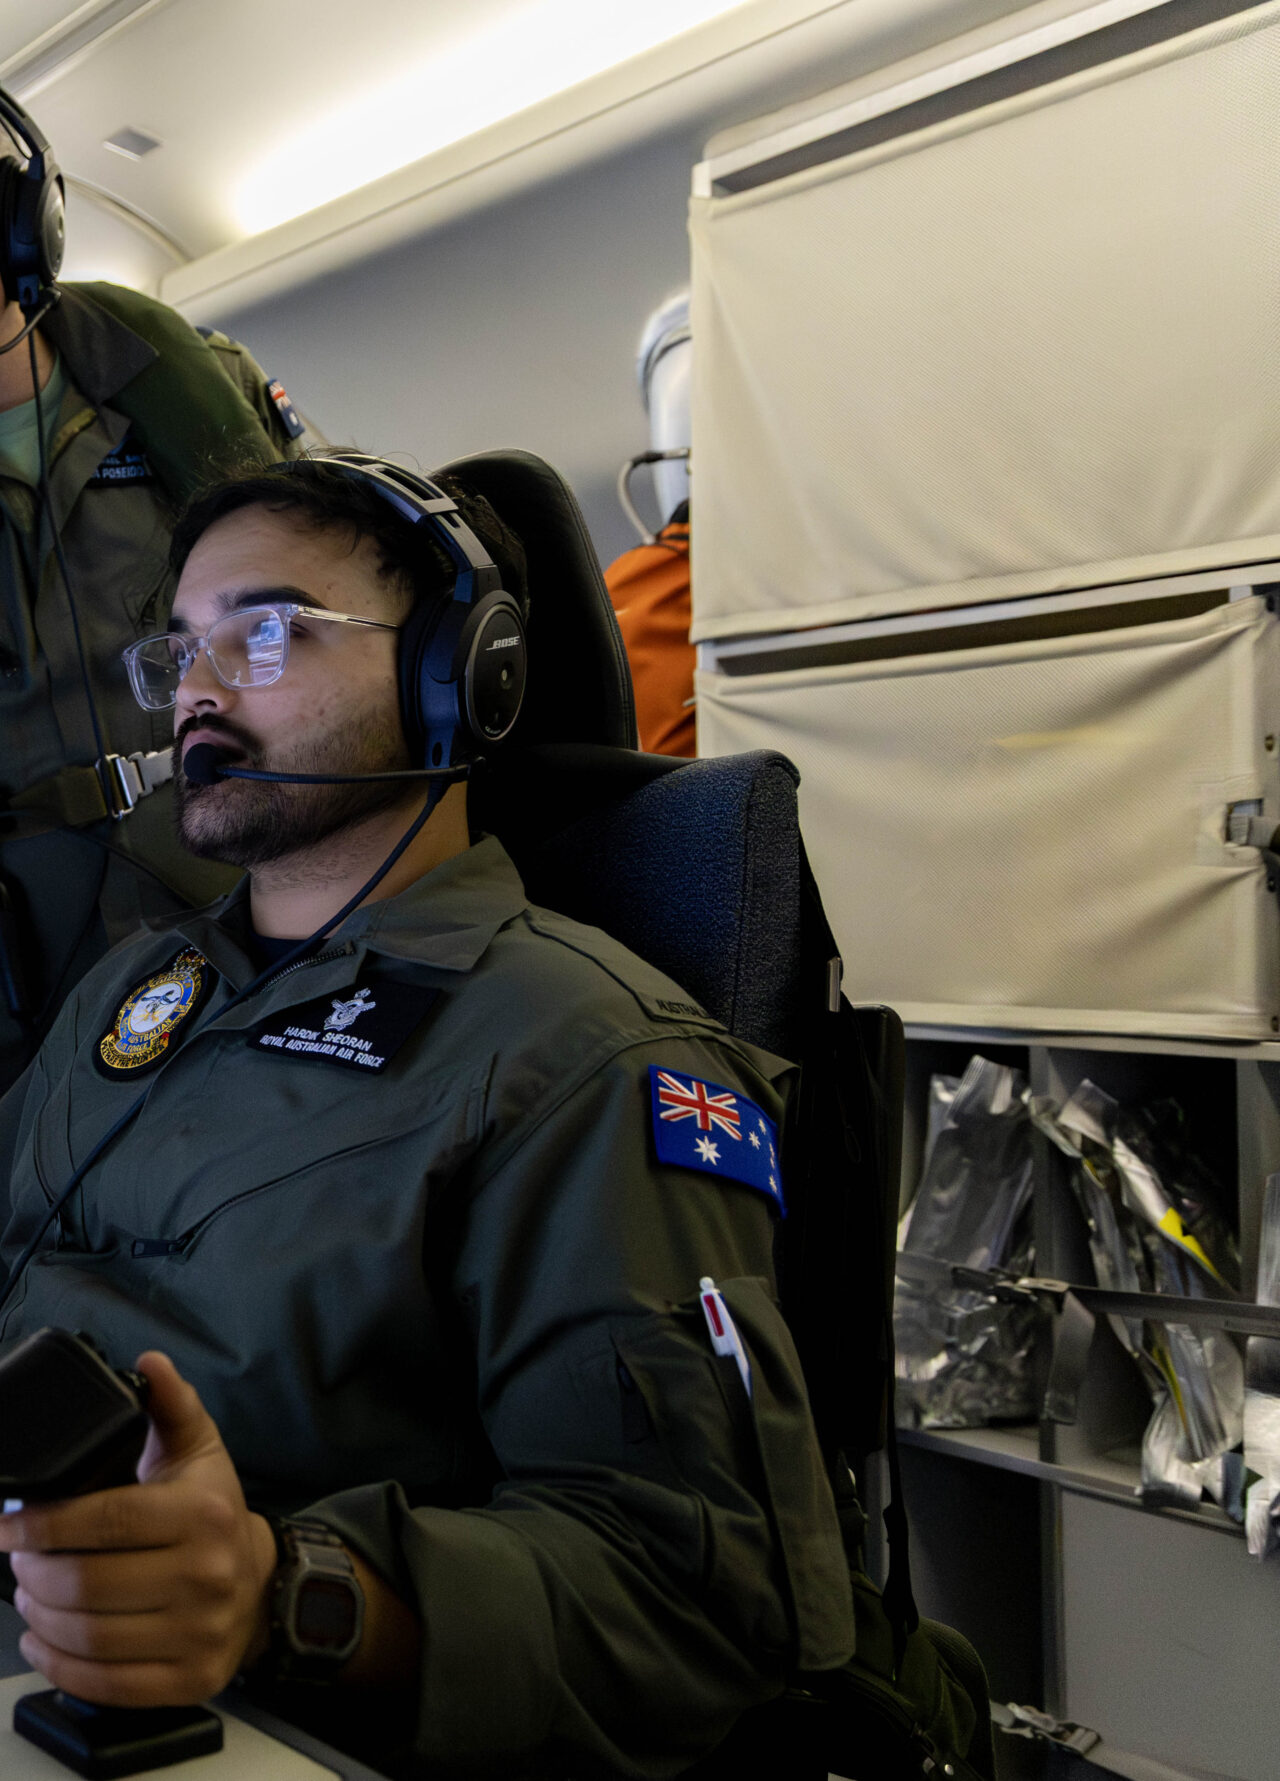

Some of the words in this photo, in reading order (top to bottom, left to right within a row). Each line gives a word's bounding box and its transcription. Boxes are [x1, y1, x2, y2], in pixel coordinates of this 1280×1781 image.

[487, 636, 520, 650] BOSE
[259, 1034, 286, 1048] ROYAL
[285, 1038, 338, 1055] AUSTRALIAN
[335, 1047, 356, 1060] AIR
[354, 1052, 385, 1068] FORCE
[283, 1026, 321, 1040] HARDIK
[322, 1032, 374, 1051] SHEORAN
